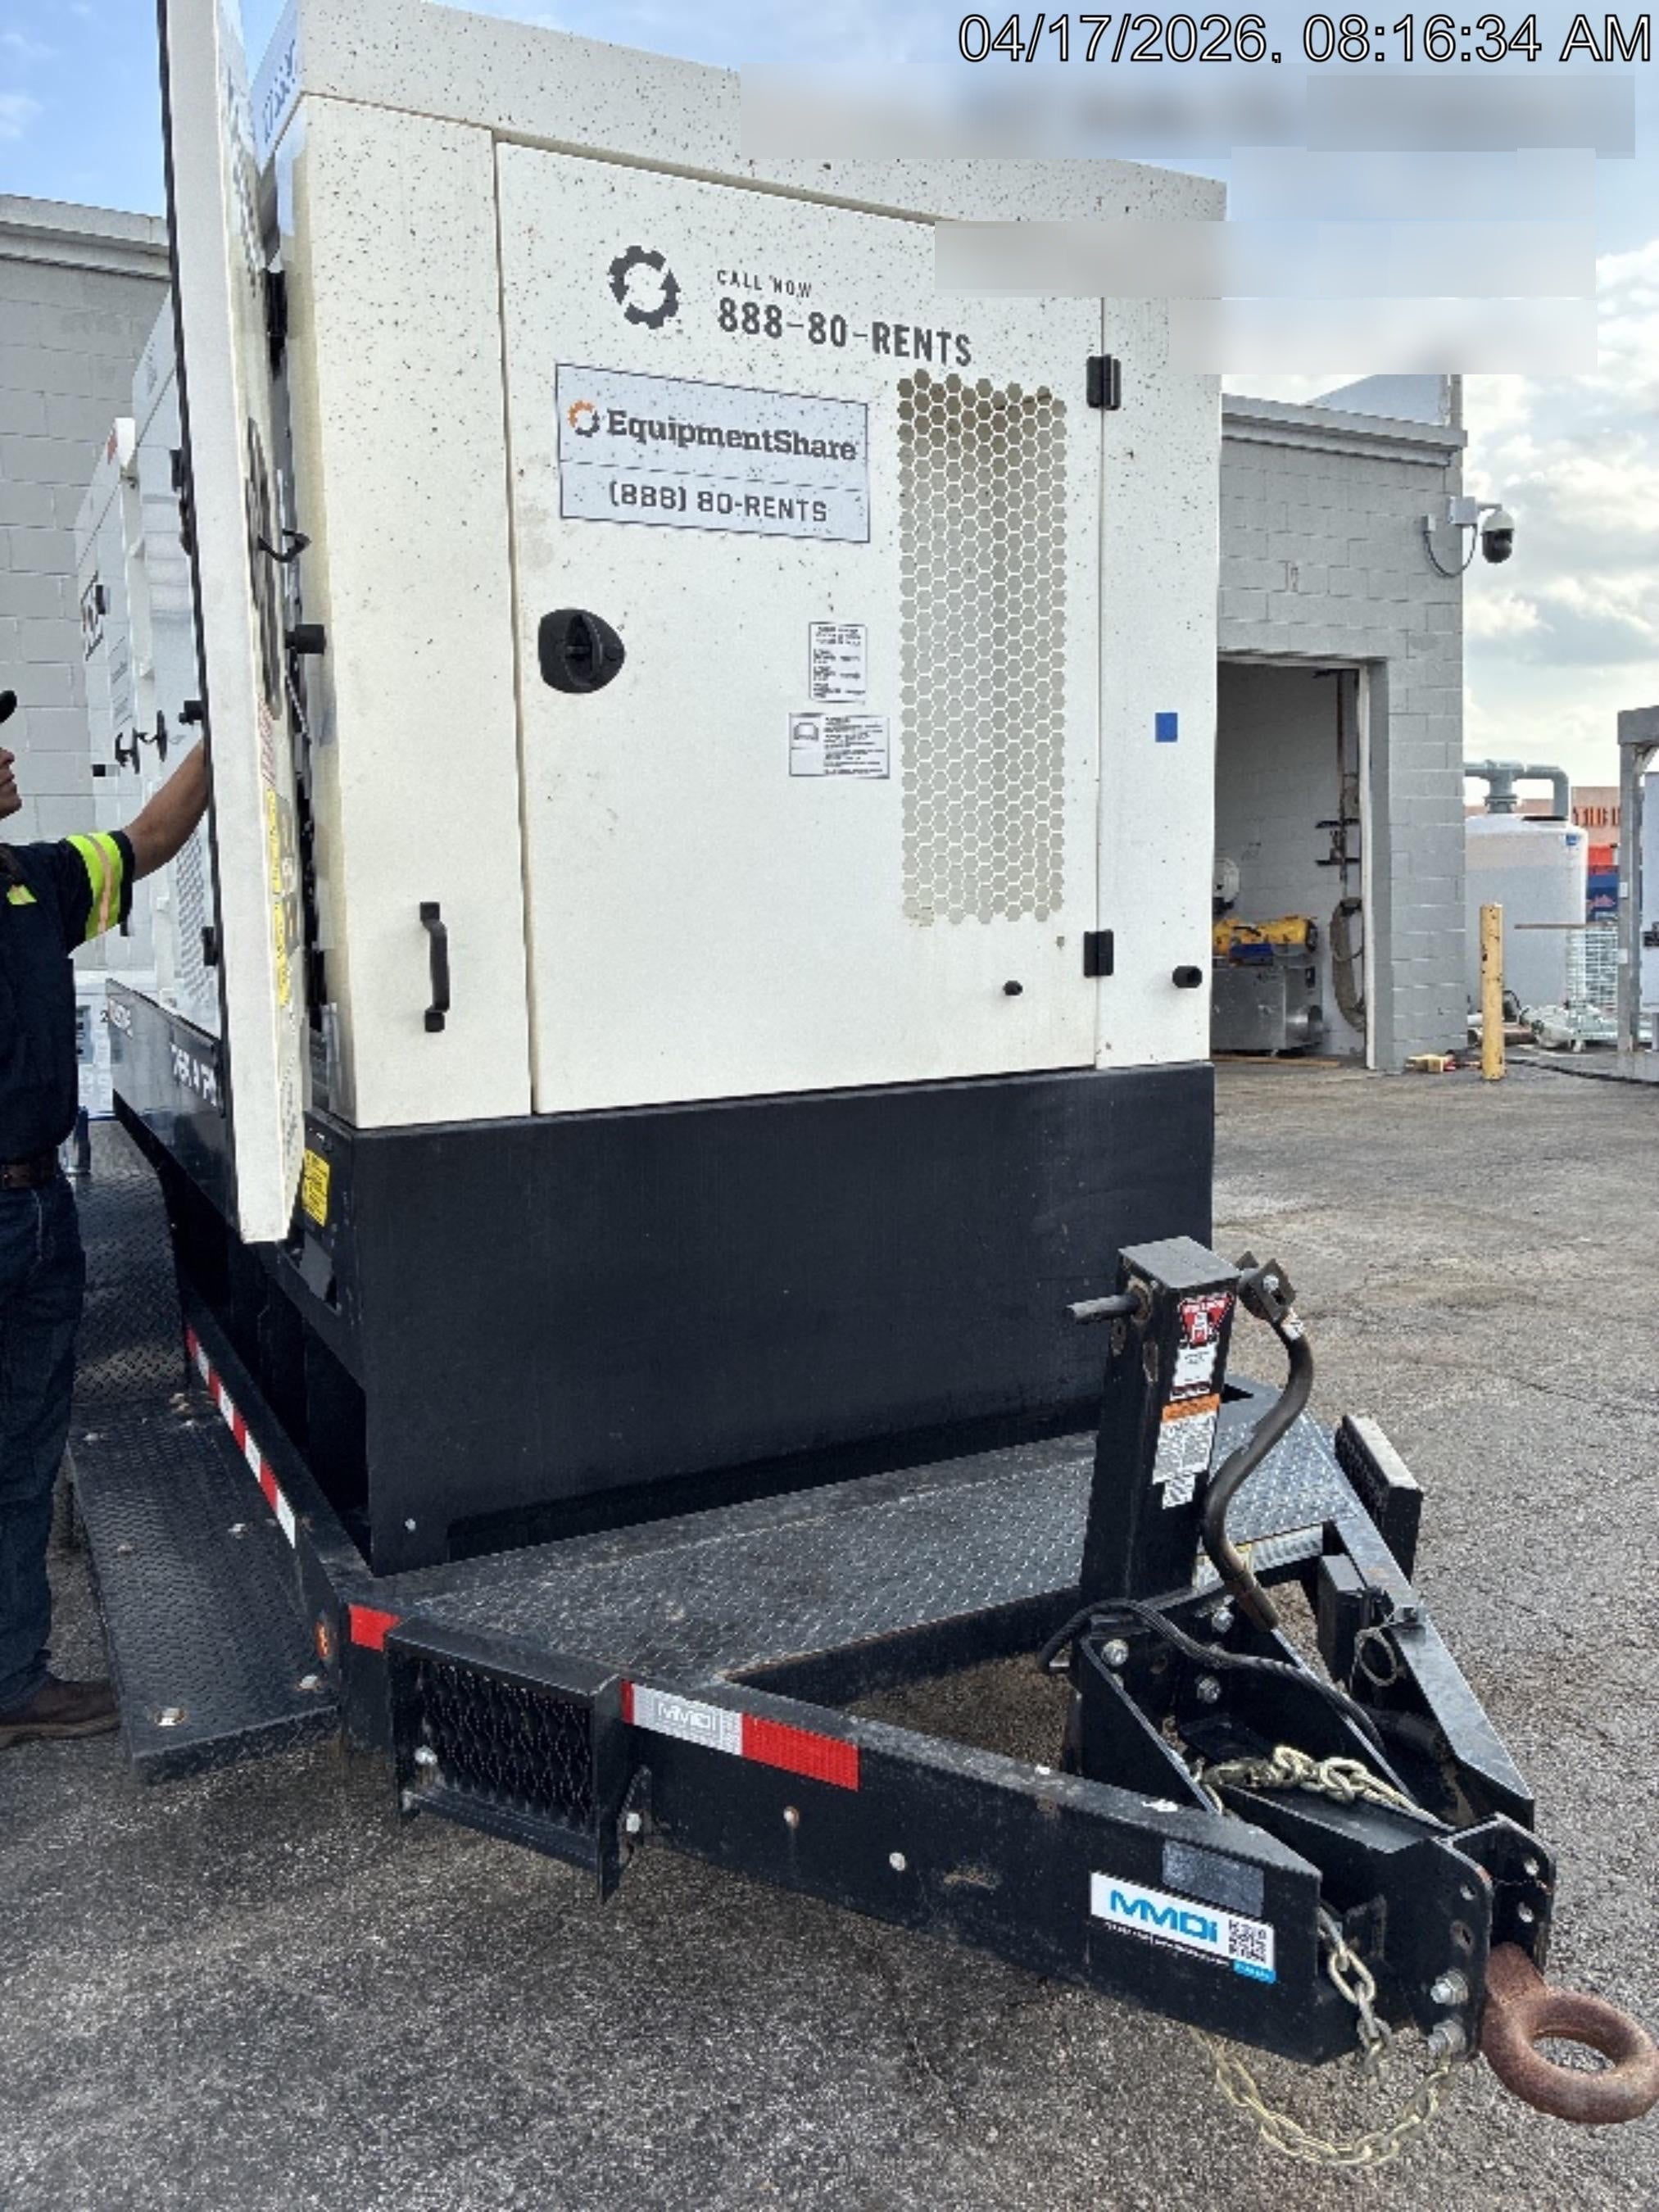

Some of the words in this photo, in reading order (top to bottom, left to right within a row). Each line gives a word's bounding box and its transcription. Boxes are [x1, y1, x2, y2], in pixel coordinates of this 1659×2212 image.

[717, 270, 762, 291] CALL
[773, 276, 812, 297] NOW
[718, 297, 972, 367] 888-80-RENTS
[606, 409, 857, 460] EquipmentShare
[609, 480, 687, 511] (888)
[696, 491, 827, 522] 80-RENTS
